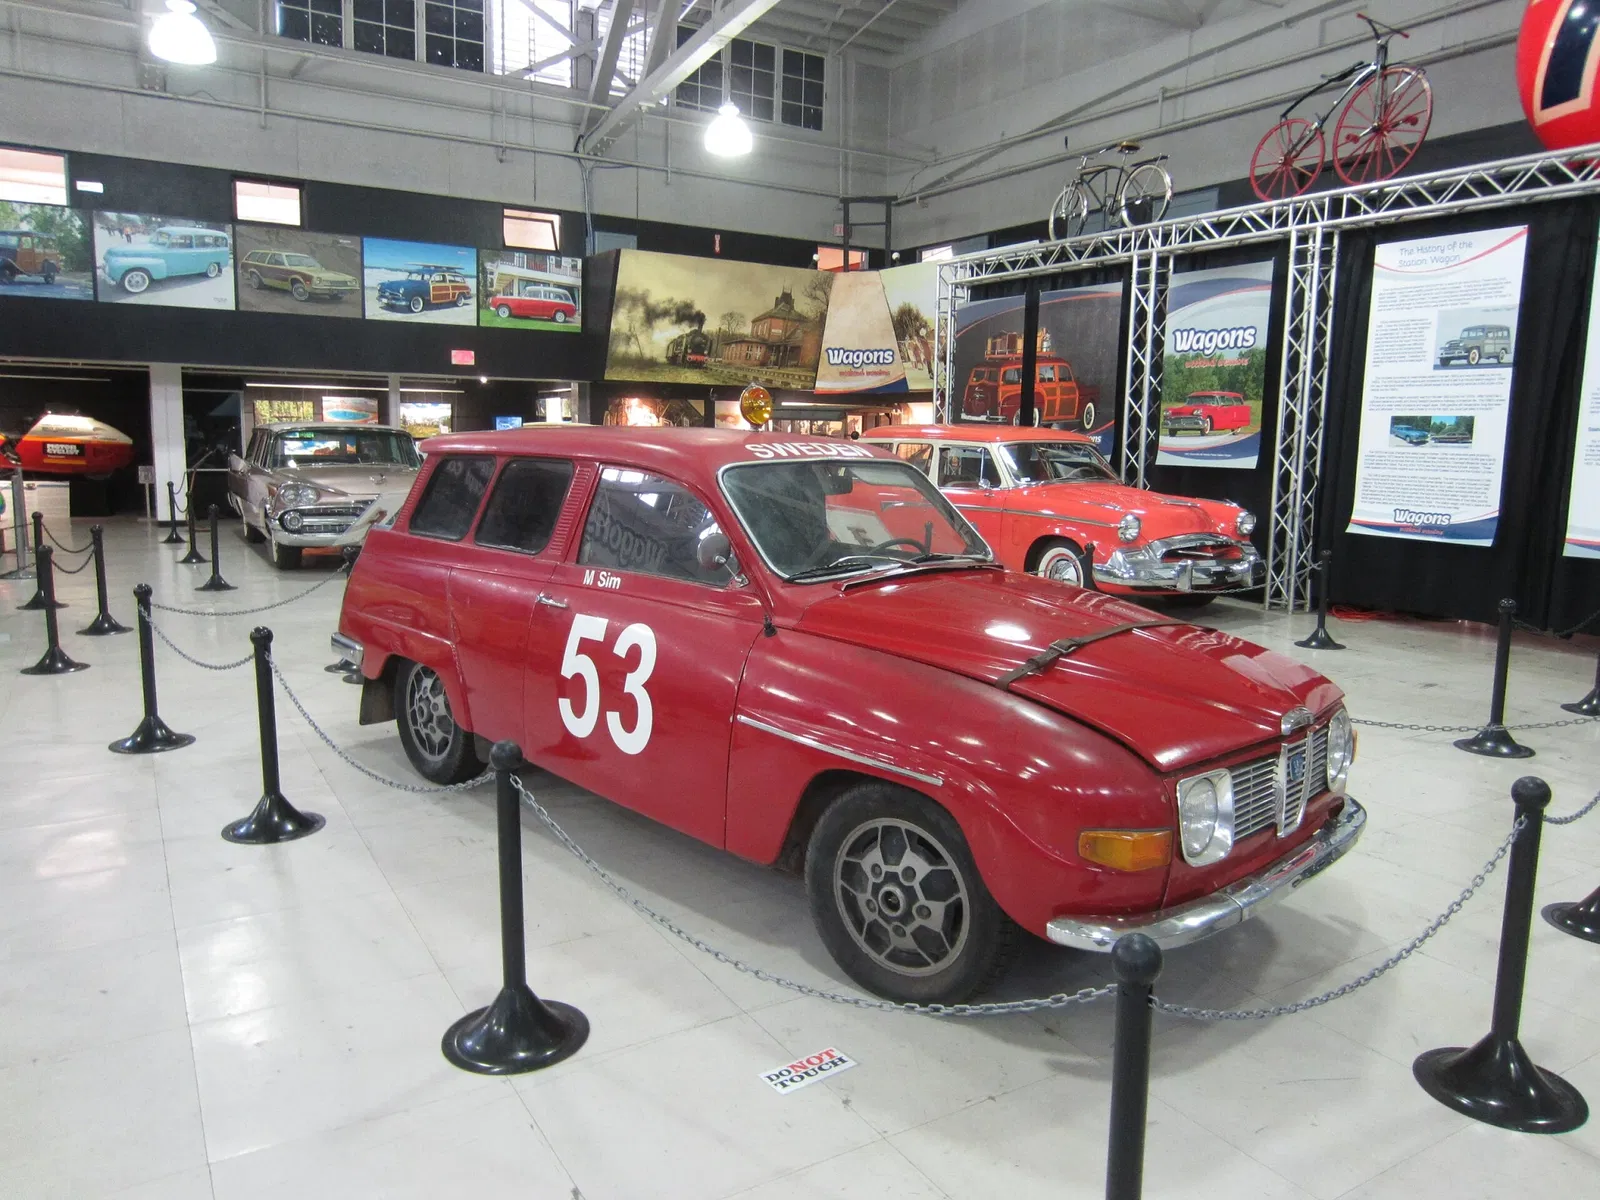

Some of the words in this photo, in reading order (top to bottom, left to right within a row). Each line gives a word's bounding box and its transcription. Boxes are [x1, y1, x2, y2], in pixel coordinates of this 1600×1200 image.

[1400, 247, 1414, 256] The
[1416, 245, 1445, 254] History
[1446, 241, 1458, 252] of
[1459, 240, 1473, 250] the
[1398, 258, 1428, 268] Station
[1430, 254, 1461, 265] Wagon
[1173, 326, 1257, 356] Wagons
[826, 347, 895, 368] Wagons
[744, 442, 874, 458] SWEDEN
[1393, 508, 1451, 526] Wagons
[583, 569, 595, 585] M
[597, 571, 621, 589] Sim
[558, 613, 657, 755] 53
[773, 1056, 848, 1089] TOUCH
